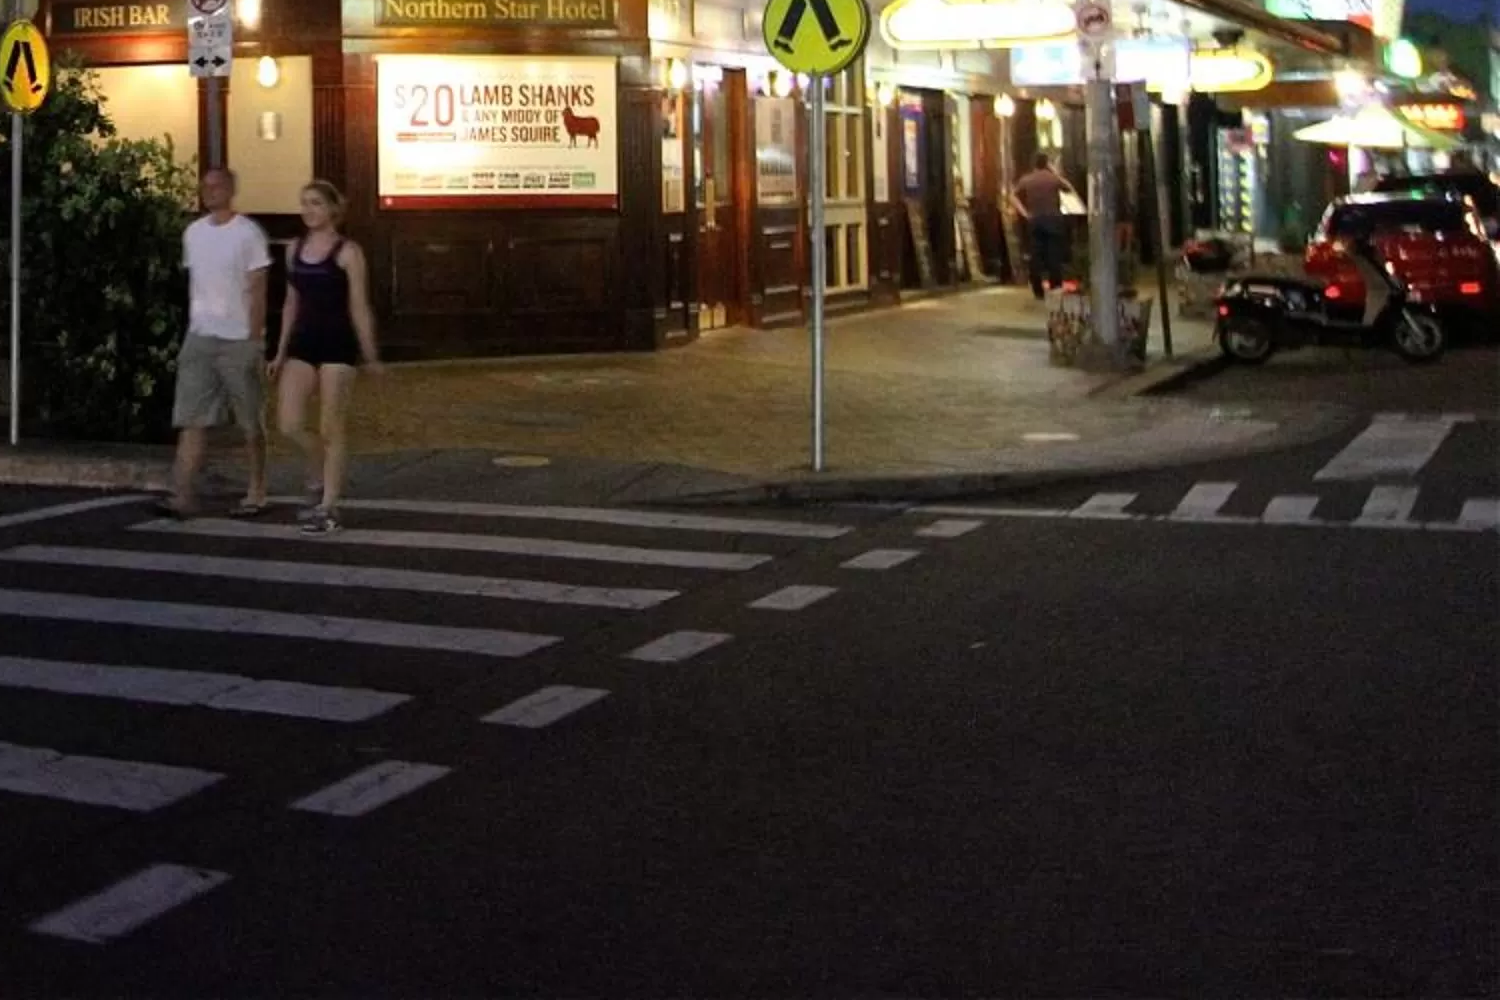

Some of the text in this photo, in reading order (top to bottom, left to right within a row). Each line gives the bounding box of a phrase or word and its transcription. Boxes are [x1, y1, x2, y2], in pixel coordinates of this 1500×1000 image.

[73, 3, 171, 28] IRISH BAR
[394, 83, 595, 127] $20 LAMB SHANKS
[473, 109, 499, 123] ANY
[501, 109, 542, 124] MIDDY
[544, 109, 561, 123] OF
[460, 125, 508, 142] JAMES
[511, 125, 561, 143] SQUIRE
